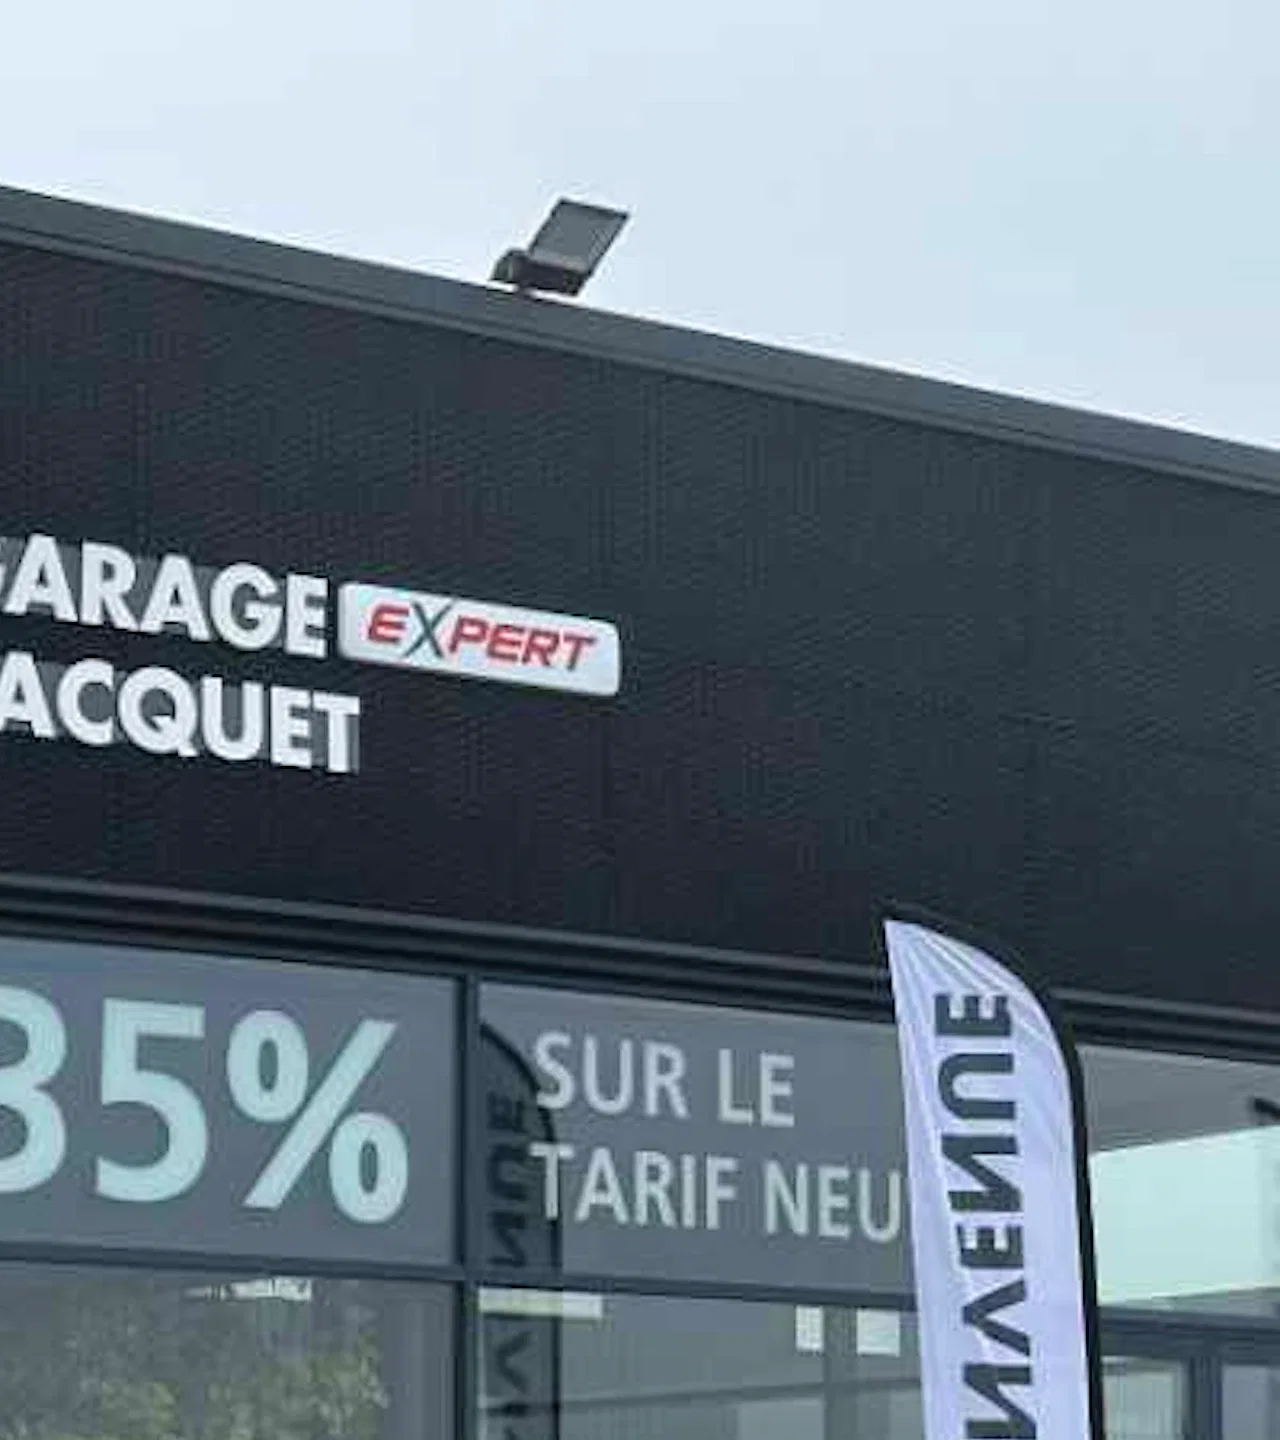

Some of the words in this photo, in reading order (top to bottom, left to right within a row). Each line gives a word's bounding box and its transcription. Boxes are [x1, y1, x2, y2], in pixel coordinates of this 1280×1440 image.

[367, 598, 596, 672] EXPERT
[534, 1031, 690, 1120] SUR
[717, 1048, 796, 1128] LE
[529, 1142, 741, 1231] TARIF
[763, 1160, 902, 1244] NEU
